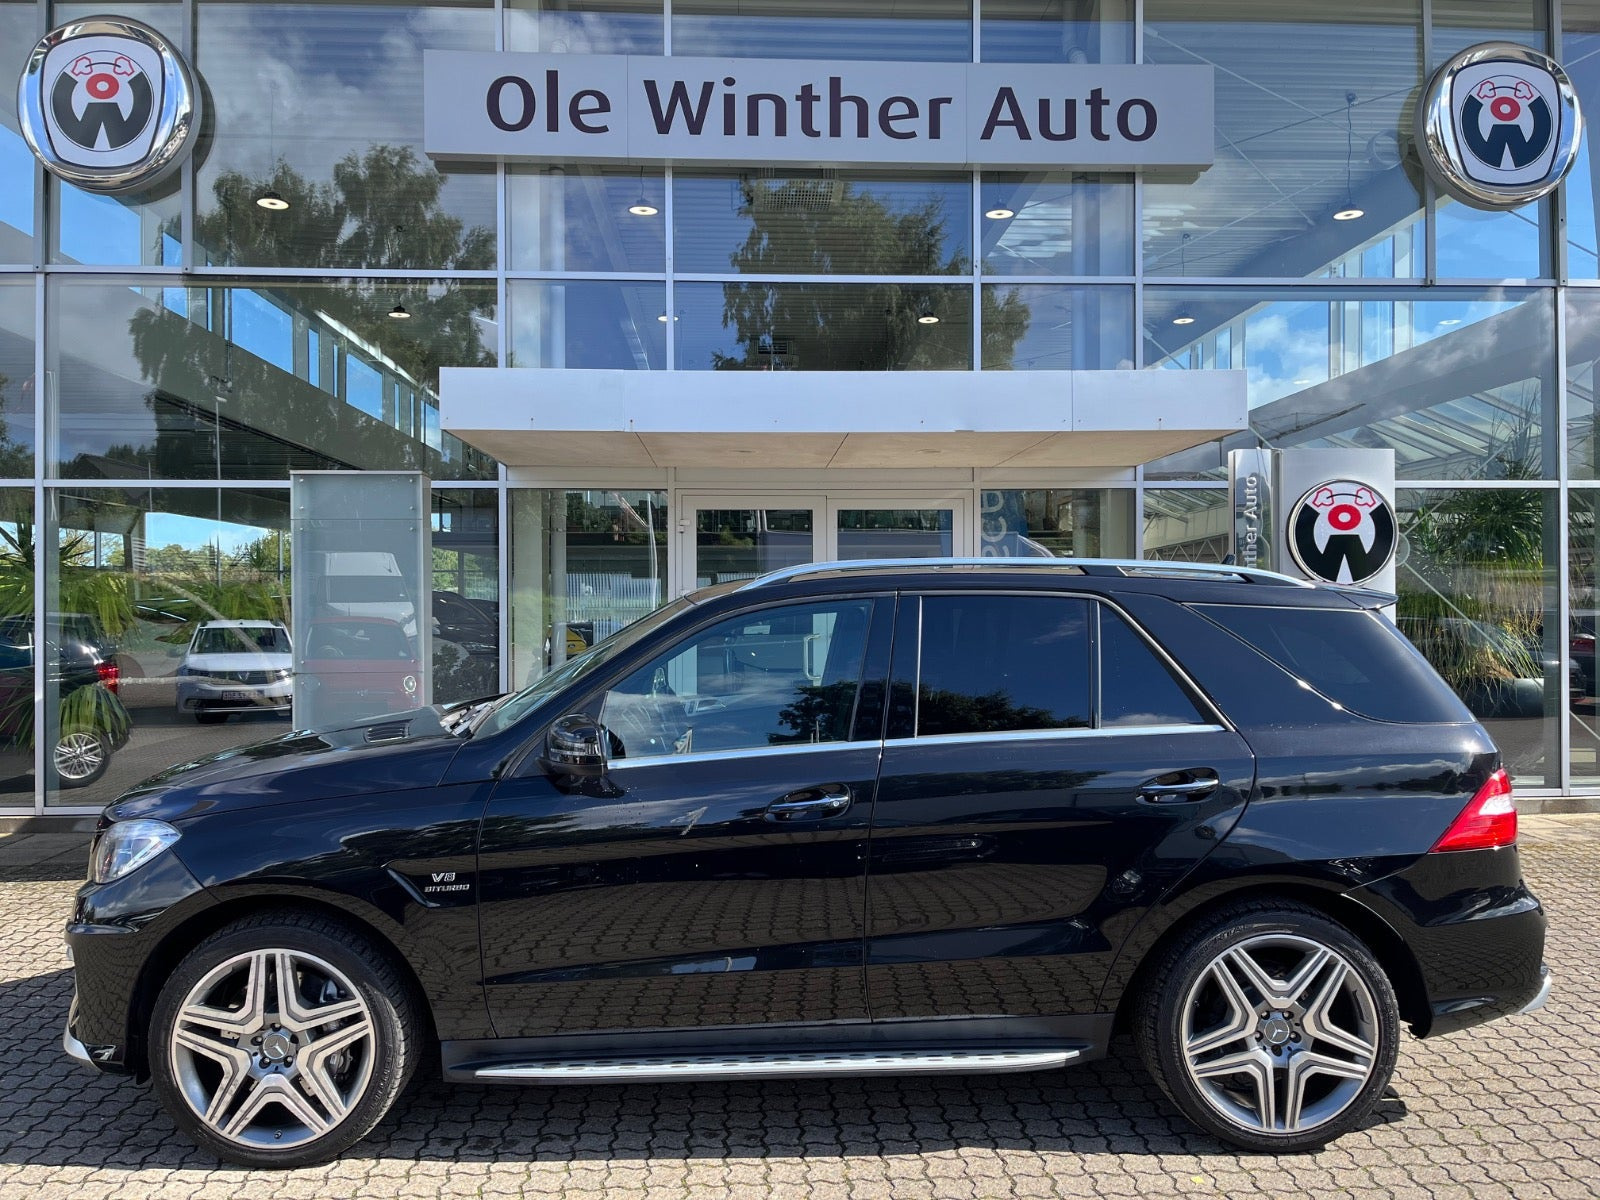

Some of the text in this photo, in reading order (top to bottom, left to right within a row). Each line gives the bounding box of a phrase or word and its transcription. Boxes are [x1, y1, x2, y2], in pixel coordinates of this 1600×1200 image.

[486, 69, 1159, 142] Ole Winther Auto
[1243, 476, 1258, 520] Auto
[423, 883, 471, 893] BITURBO
[431, 871, 456, 883] V8
